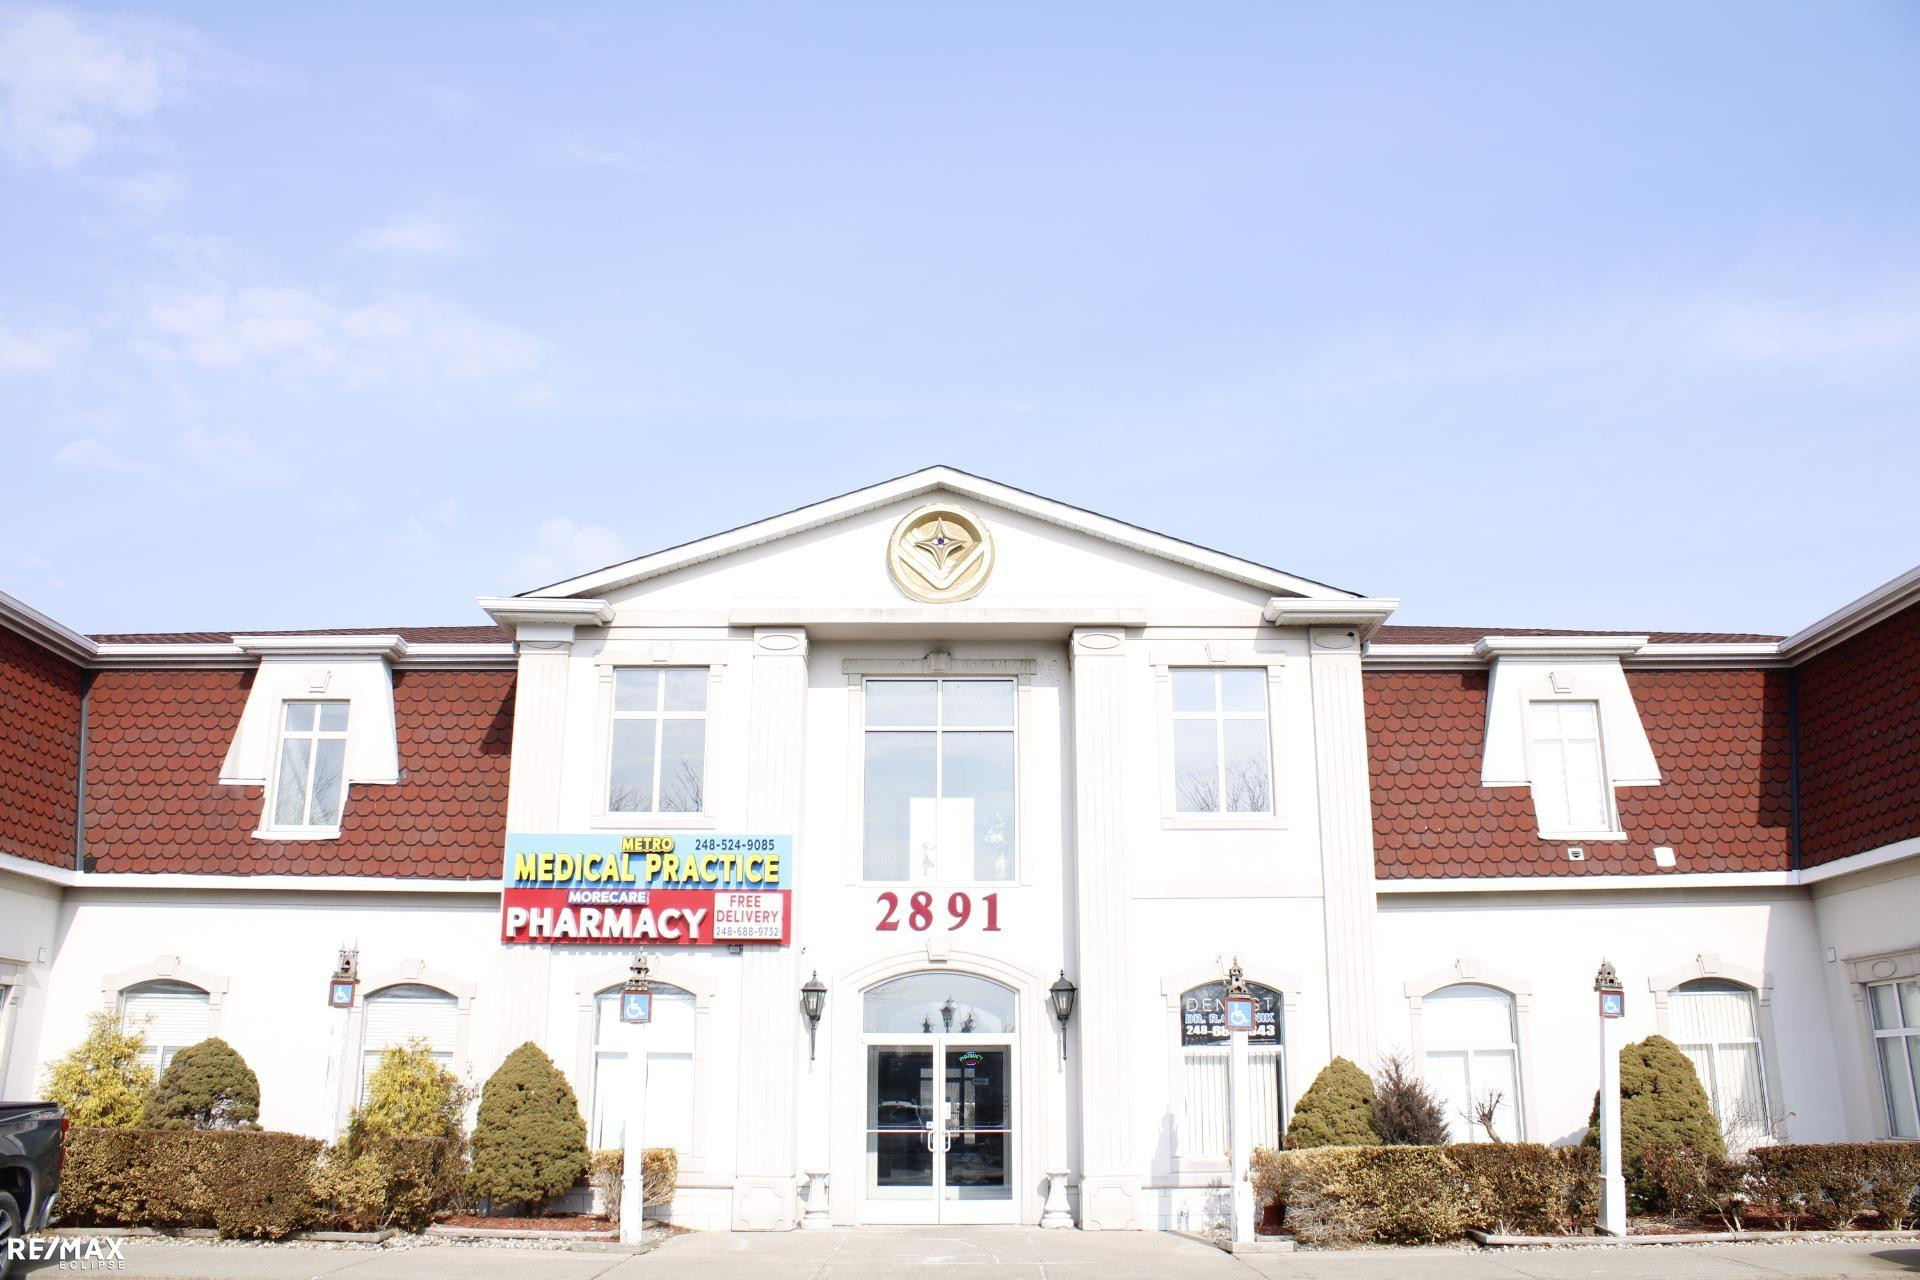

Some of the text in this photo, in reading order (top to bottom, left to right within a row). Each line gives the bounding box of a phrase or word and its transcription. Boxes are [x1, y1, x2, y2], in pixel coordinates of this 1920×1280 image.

[621, 836, 675, 852] METRO
[695, 839, 775, 851] 248-524-9085
[514, 853, 780, 884] MEDICAL PRACTICE
[568, 890, 649, 905] MORECARE
[730, 895, 761, 908] FREE
[716, 910, 780, 923] DELIVERY
[875, 891, 1001, 931] 2891
[506, 907, 707, 939] PHARMACY
[716, 927, 779, 937] 248-688-9732
[1187, 998, 1273, 1012] DENST
